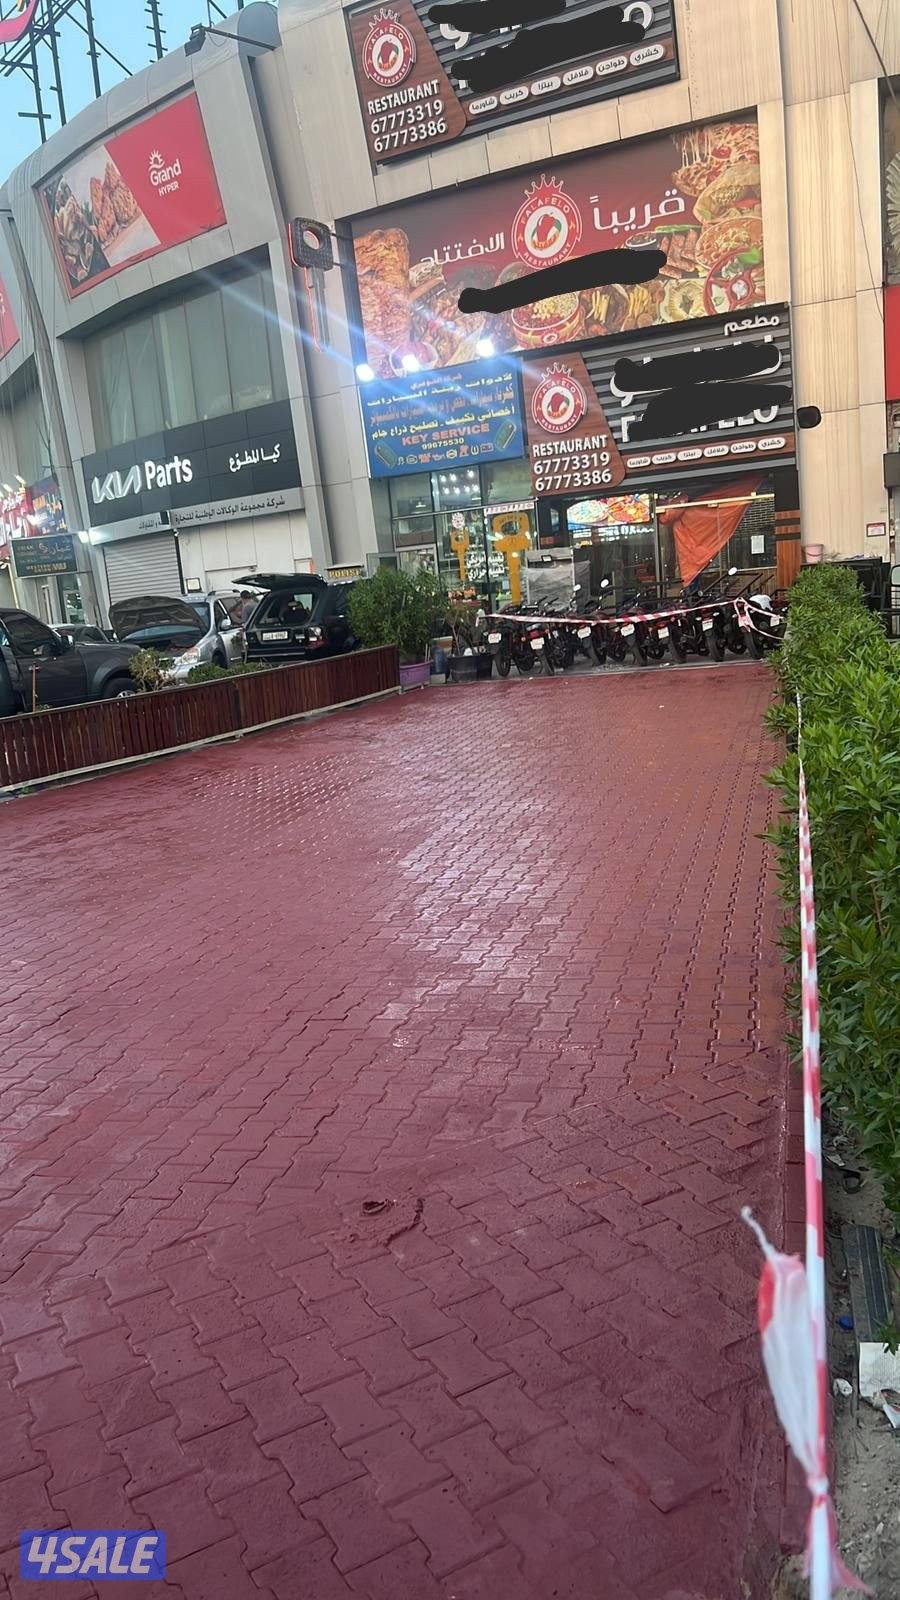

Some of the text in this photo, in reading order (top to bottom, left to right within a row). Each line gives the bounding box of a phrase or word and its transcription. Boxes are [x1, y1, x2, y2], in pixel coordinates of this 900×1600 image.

[367, 80, 439, 115] RESTAURANT
[371, 99, 443, 134] 67773319
[374, 118, 446, 152] 67773386
[151, 158, 182, 186] Grand
[158, 181, 179, 196] HYPER
[521, 197, 570, 224] FALAFELO
[419, 231, 505, 272] الافتتاح
[523, 242, 571, 267] RESTAURANT
[724, 315, 780, 336] مطعم
[402, 423, 490, 446] KEY SERVICE
[532, 434, 607, 457] RESTAURANT
[260, 443, 280, 463] كيا
[534, 452, 610, 475] 67773319
[144, 455, 193, 490] Parts
[535, 469, 612, 491] 67773386
[240, 502, 266, 512] مجموعة
[267, 495, 285, 509] شركة
